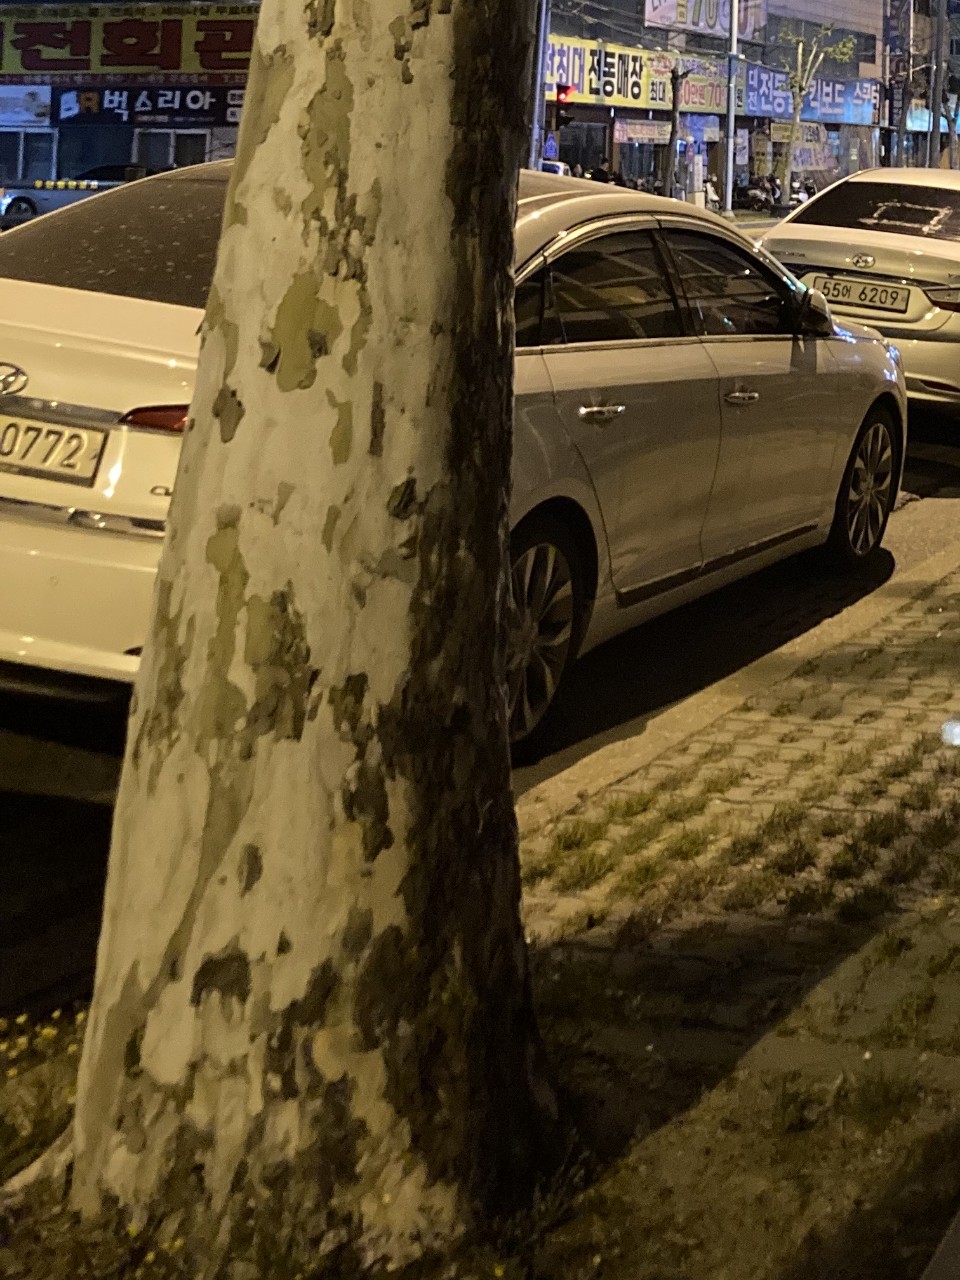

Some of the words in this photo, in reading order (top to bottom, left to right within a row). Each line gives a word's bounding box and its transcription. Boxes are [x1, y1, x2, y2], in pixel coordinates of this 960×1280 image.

[0, 18, 256, 71] 전회관
[589, 49, 644, 100] 전동매장
[104, 89, 216, 121] 벅스리아
[809, 78, 845, 115] 킥보드
[853, 82, 880, 110] 스쿠터
[859, 286, 900, 306] 6209
[0, 422, 84, 469] 0772
